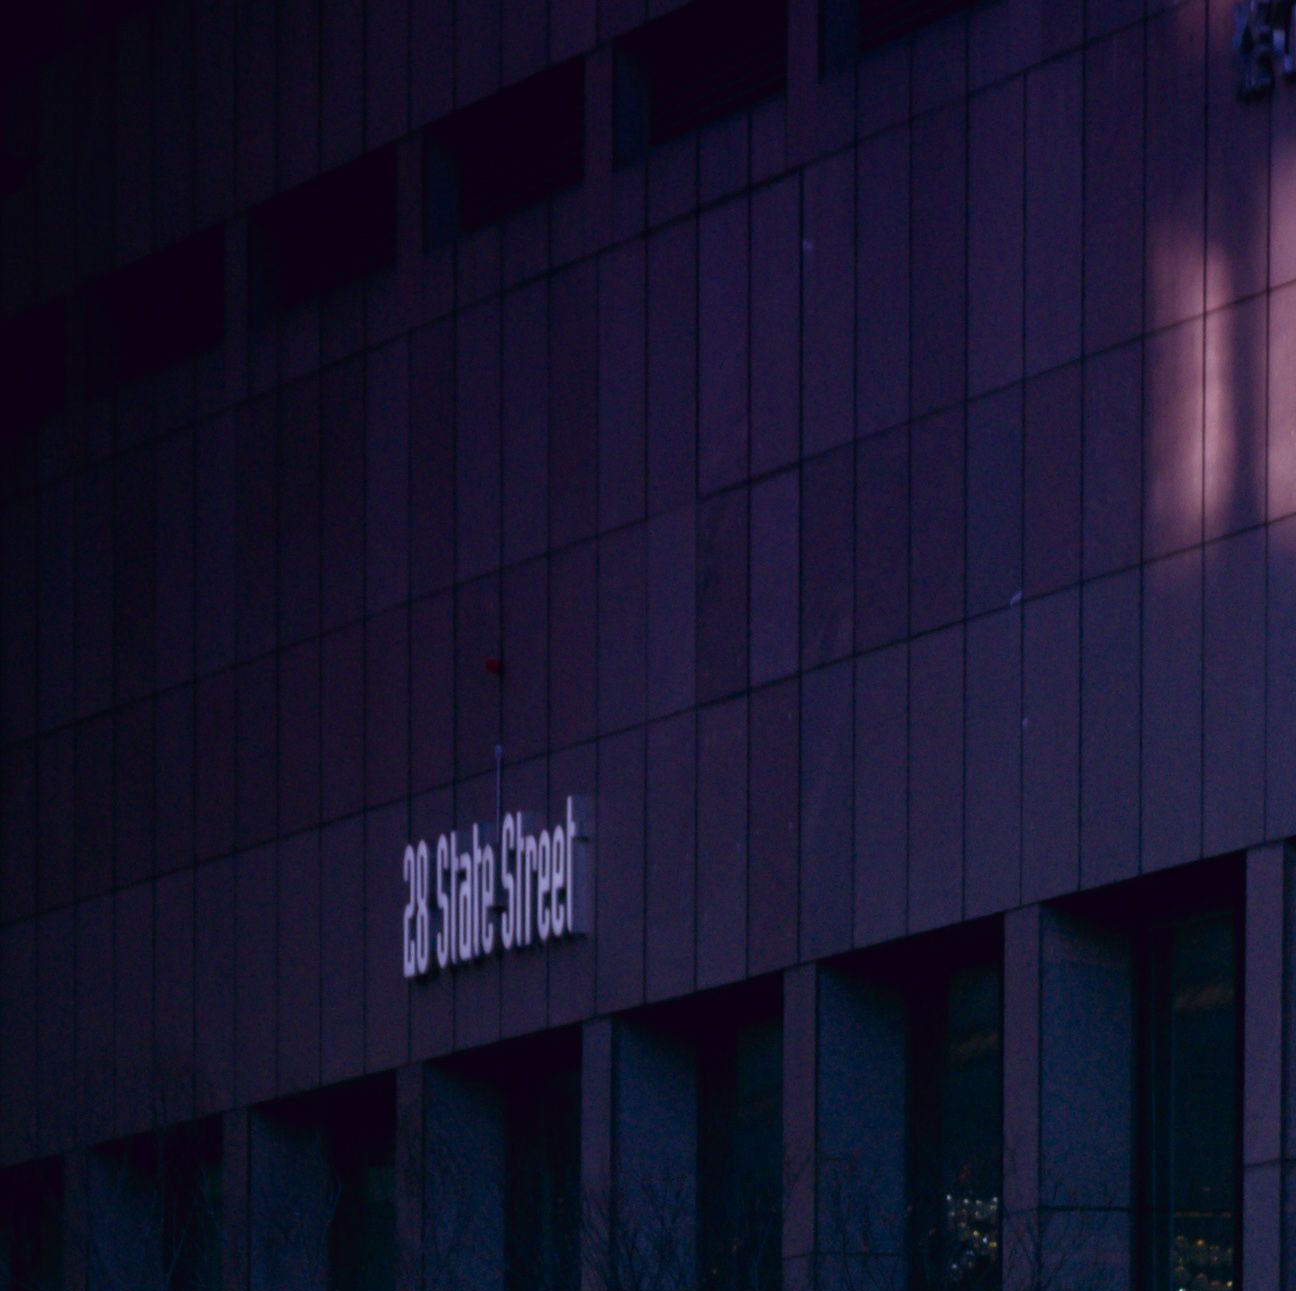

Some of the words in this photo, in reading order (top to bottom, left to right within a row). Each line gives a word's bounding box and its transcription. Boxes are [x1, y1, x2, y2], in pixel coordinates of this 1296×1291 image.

[403, 839, 430, 978] 28
[436, 822, 495, 969] State
[501, 795, 576, 950] Street
